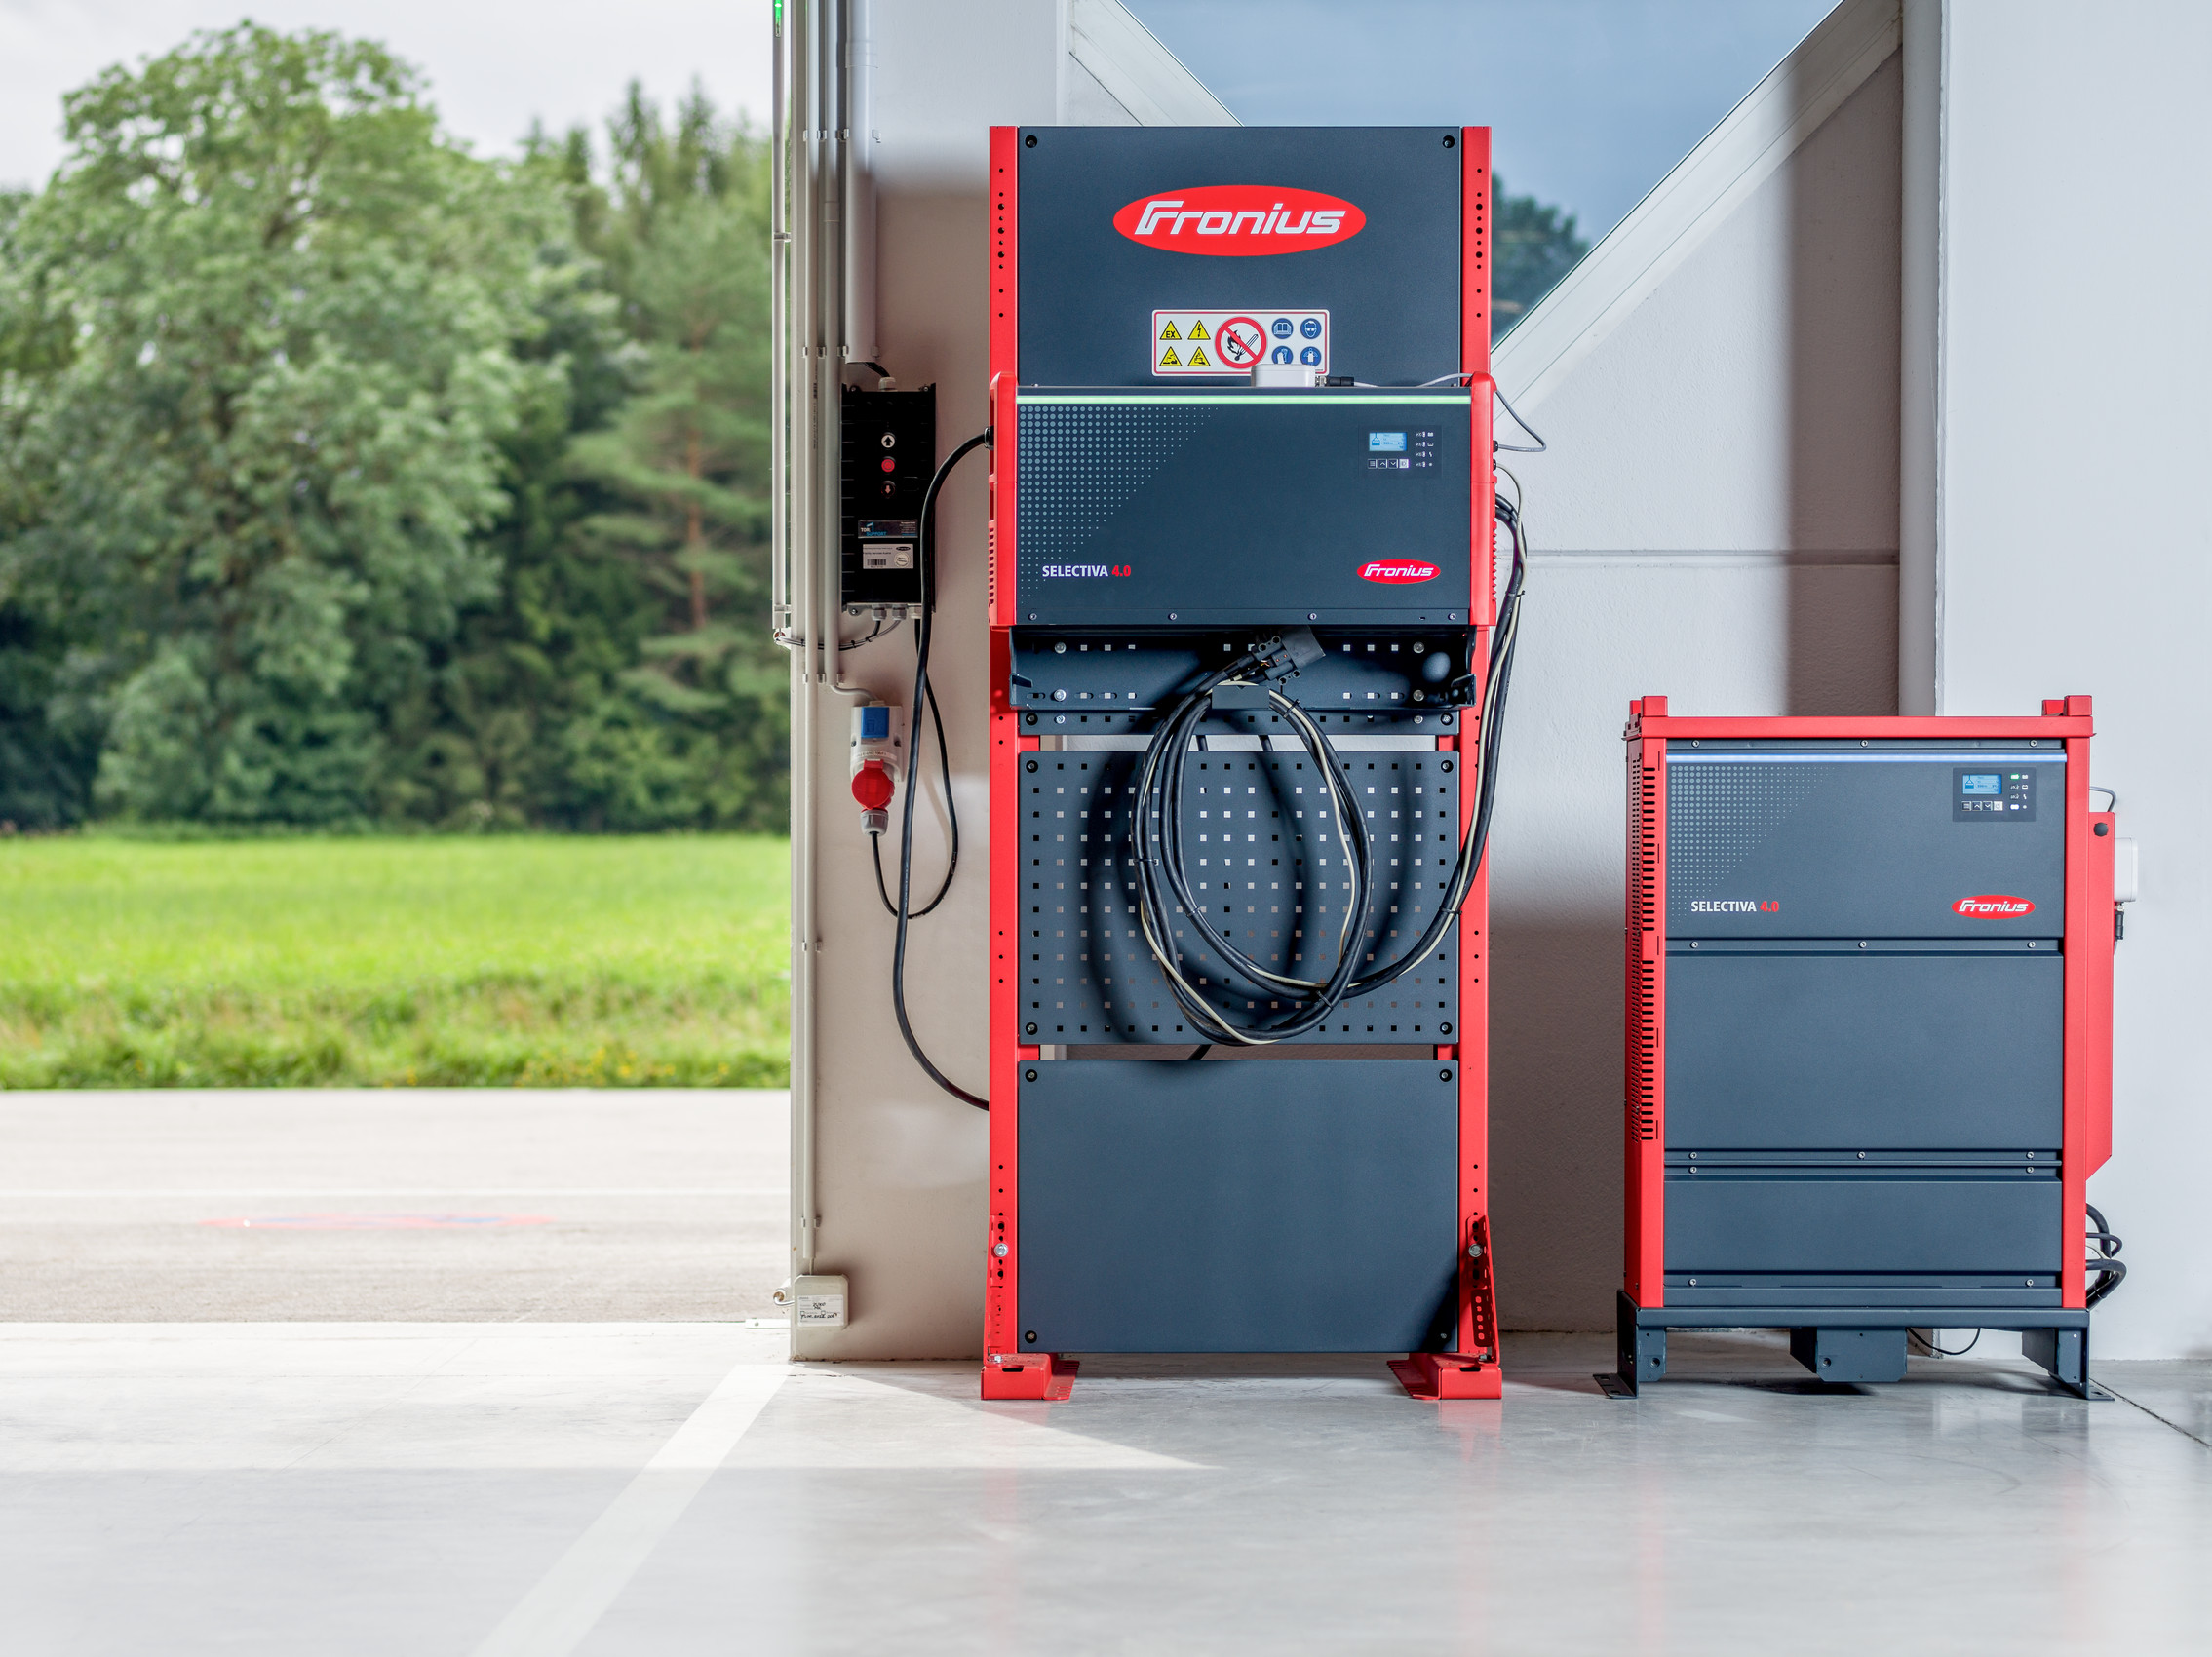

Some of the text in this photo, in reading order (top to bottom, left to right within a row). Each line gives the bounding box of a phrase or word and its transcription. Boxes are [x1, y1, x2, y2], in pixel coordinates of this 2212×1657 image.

[1134, 200, 1346, 235] Fronius
[1042, 565, 1131, 577] SELECTIVA 4.0
[1363, 563, 1434, 577] Fronius
[1690, 900, 1779, 912] SELECTIVA 4.0
[1958, 900, 2029, 912] Fronius
